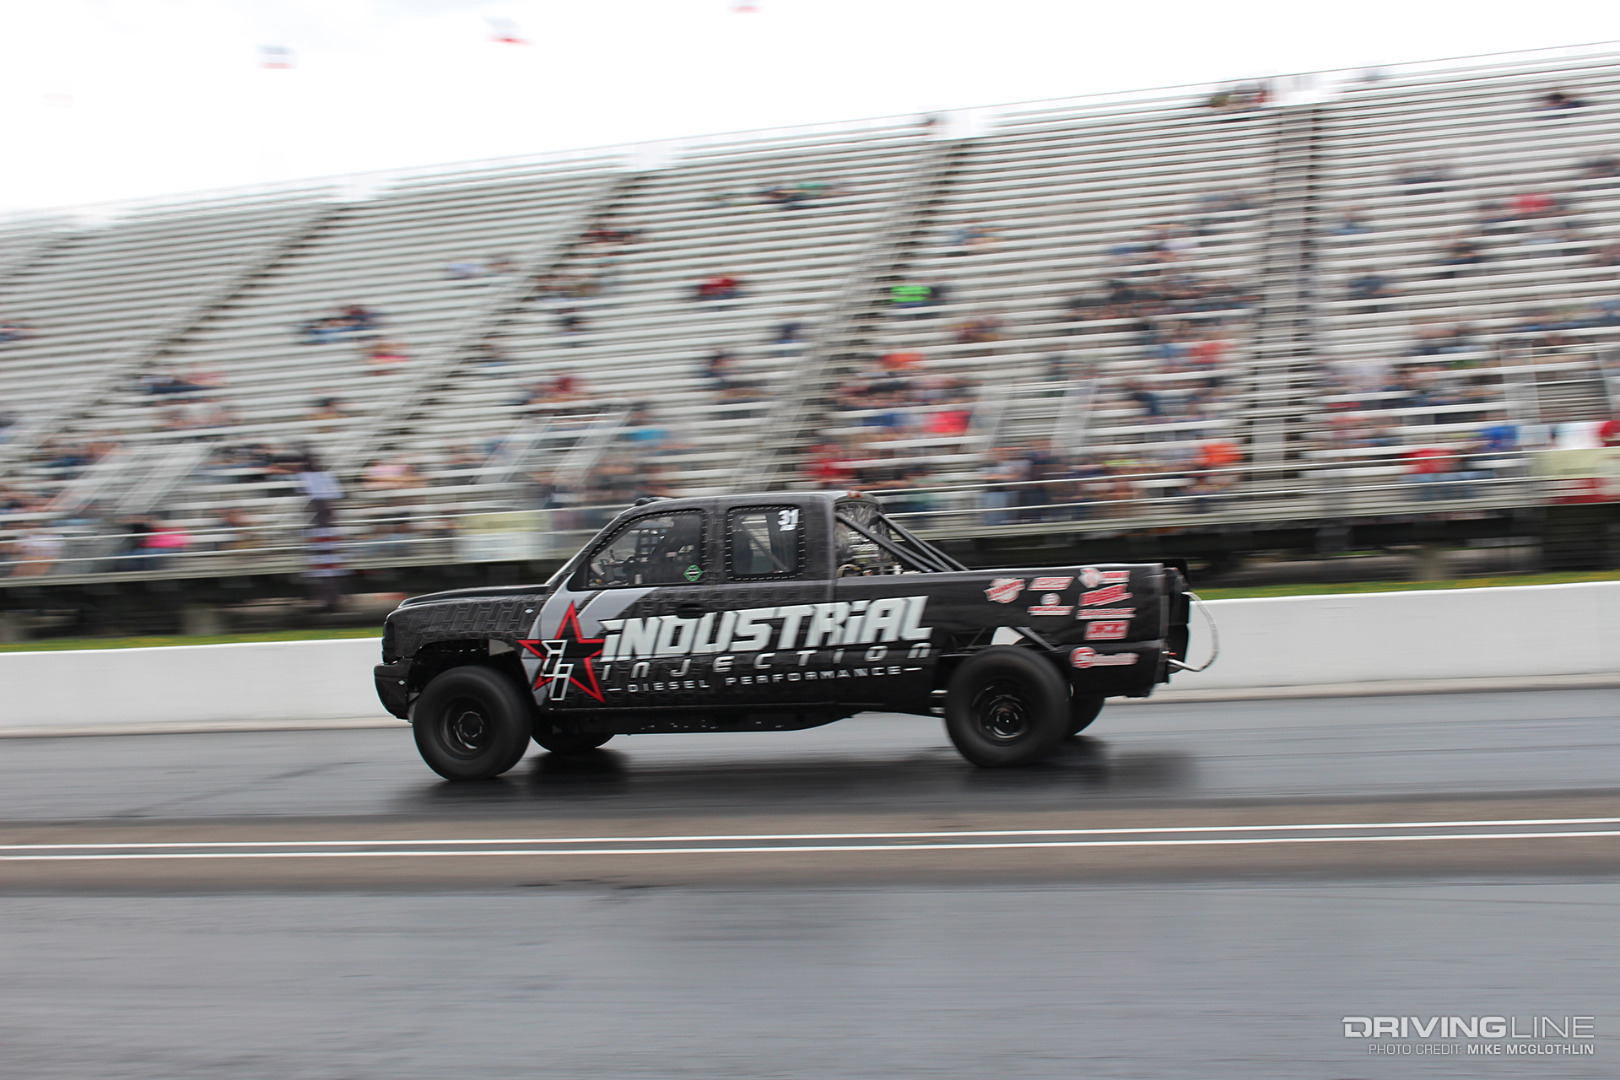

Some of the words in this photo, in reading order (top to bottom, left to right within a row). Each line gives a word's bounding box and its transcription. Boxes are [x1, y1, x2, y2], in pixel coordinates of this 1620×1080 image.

[777, 509, 799, 525] 31
[627, 680, 710, 693] DIESEL
[725, 665, 901, 686] PERFORMANCE
